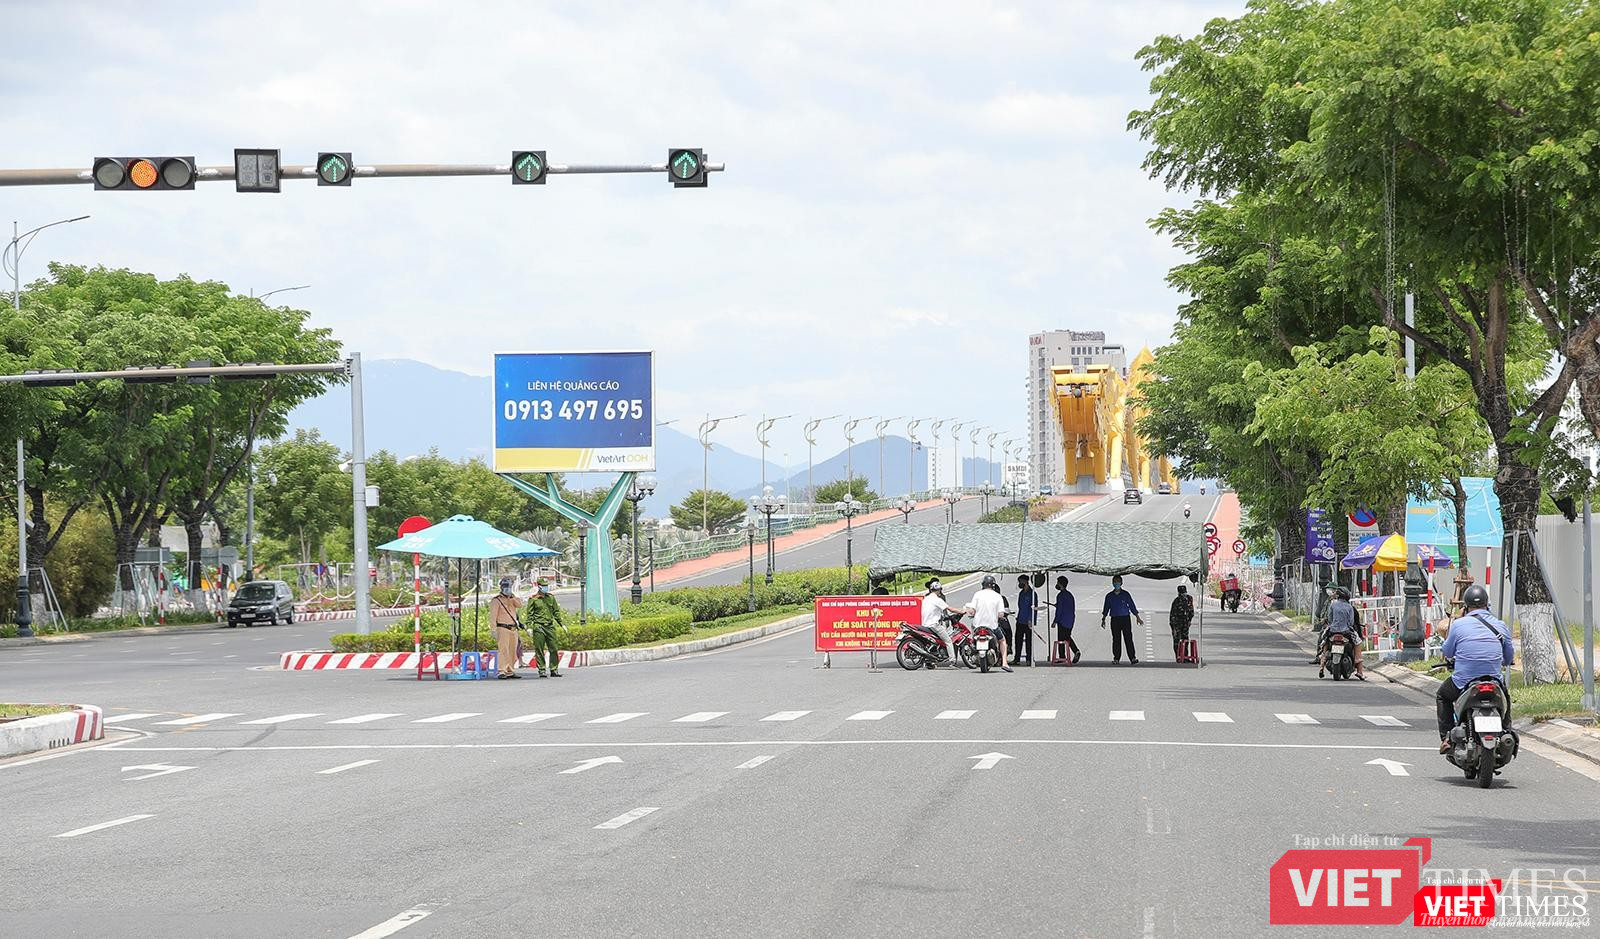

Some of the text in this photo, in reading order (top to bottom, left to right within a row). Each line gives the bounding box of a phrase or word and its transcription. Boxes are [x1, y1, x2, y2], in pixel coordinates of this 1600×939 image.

[527, 379, 620, 392] LIÊN HỆ QUẢNG CÁO
[504, 399, 643, 420] 0913 497 695
[627, 454, 648, 462] OOH
[856, 609, 869, 617] KHU
[850, 620, 867, 629] SOÁT
